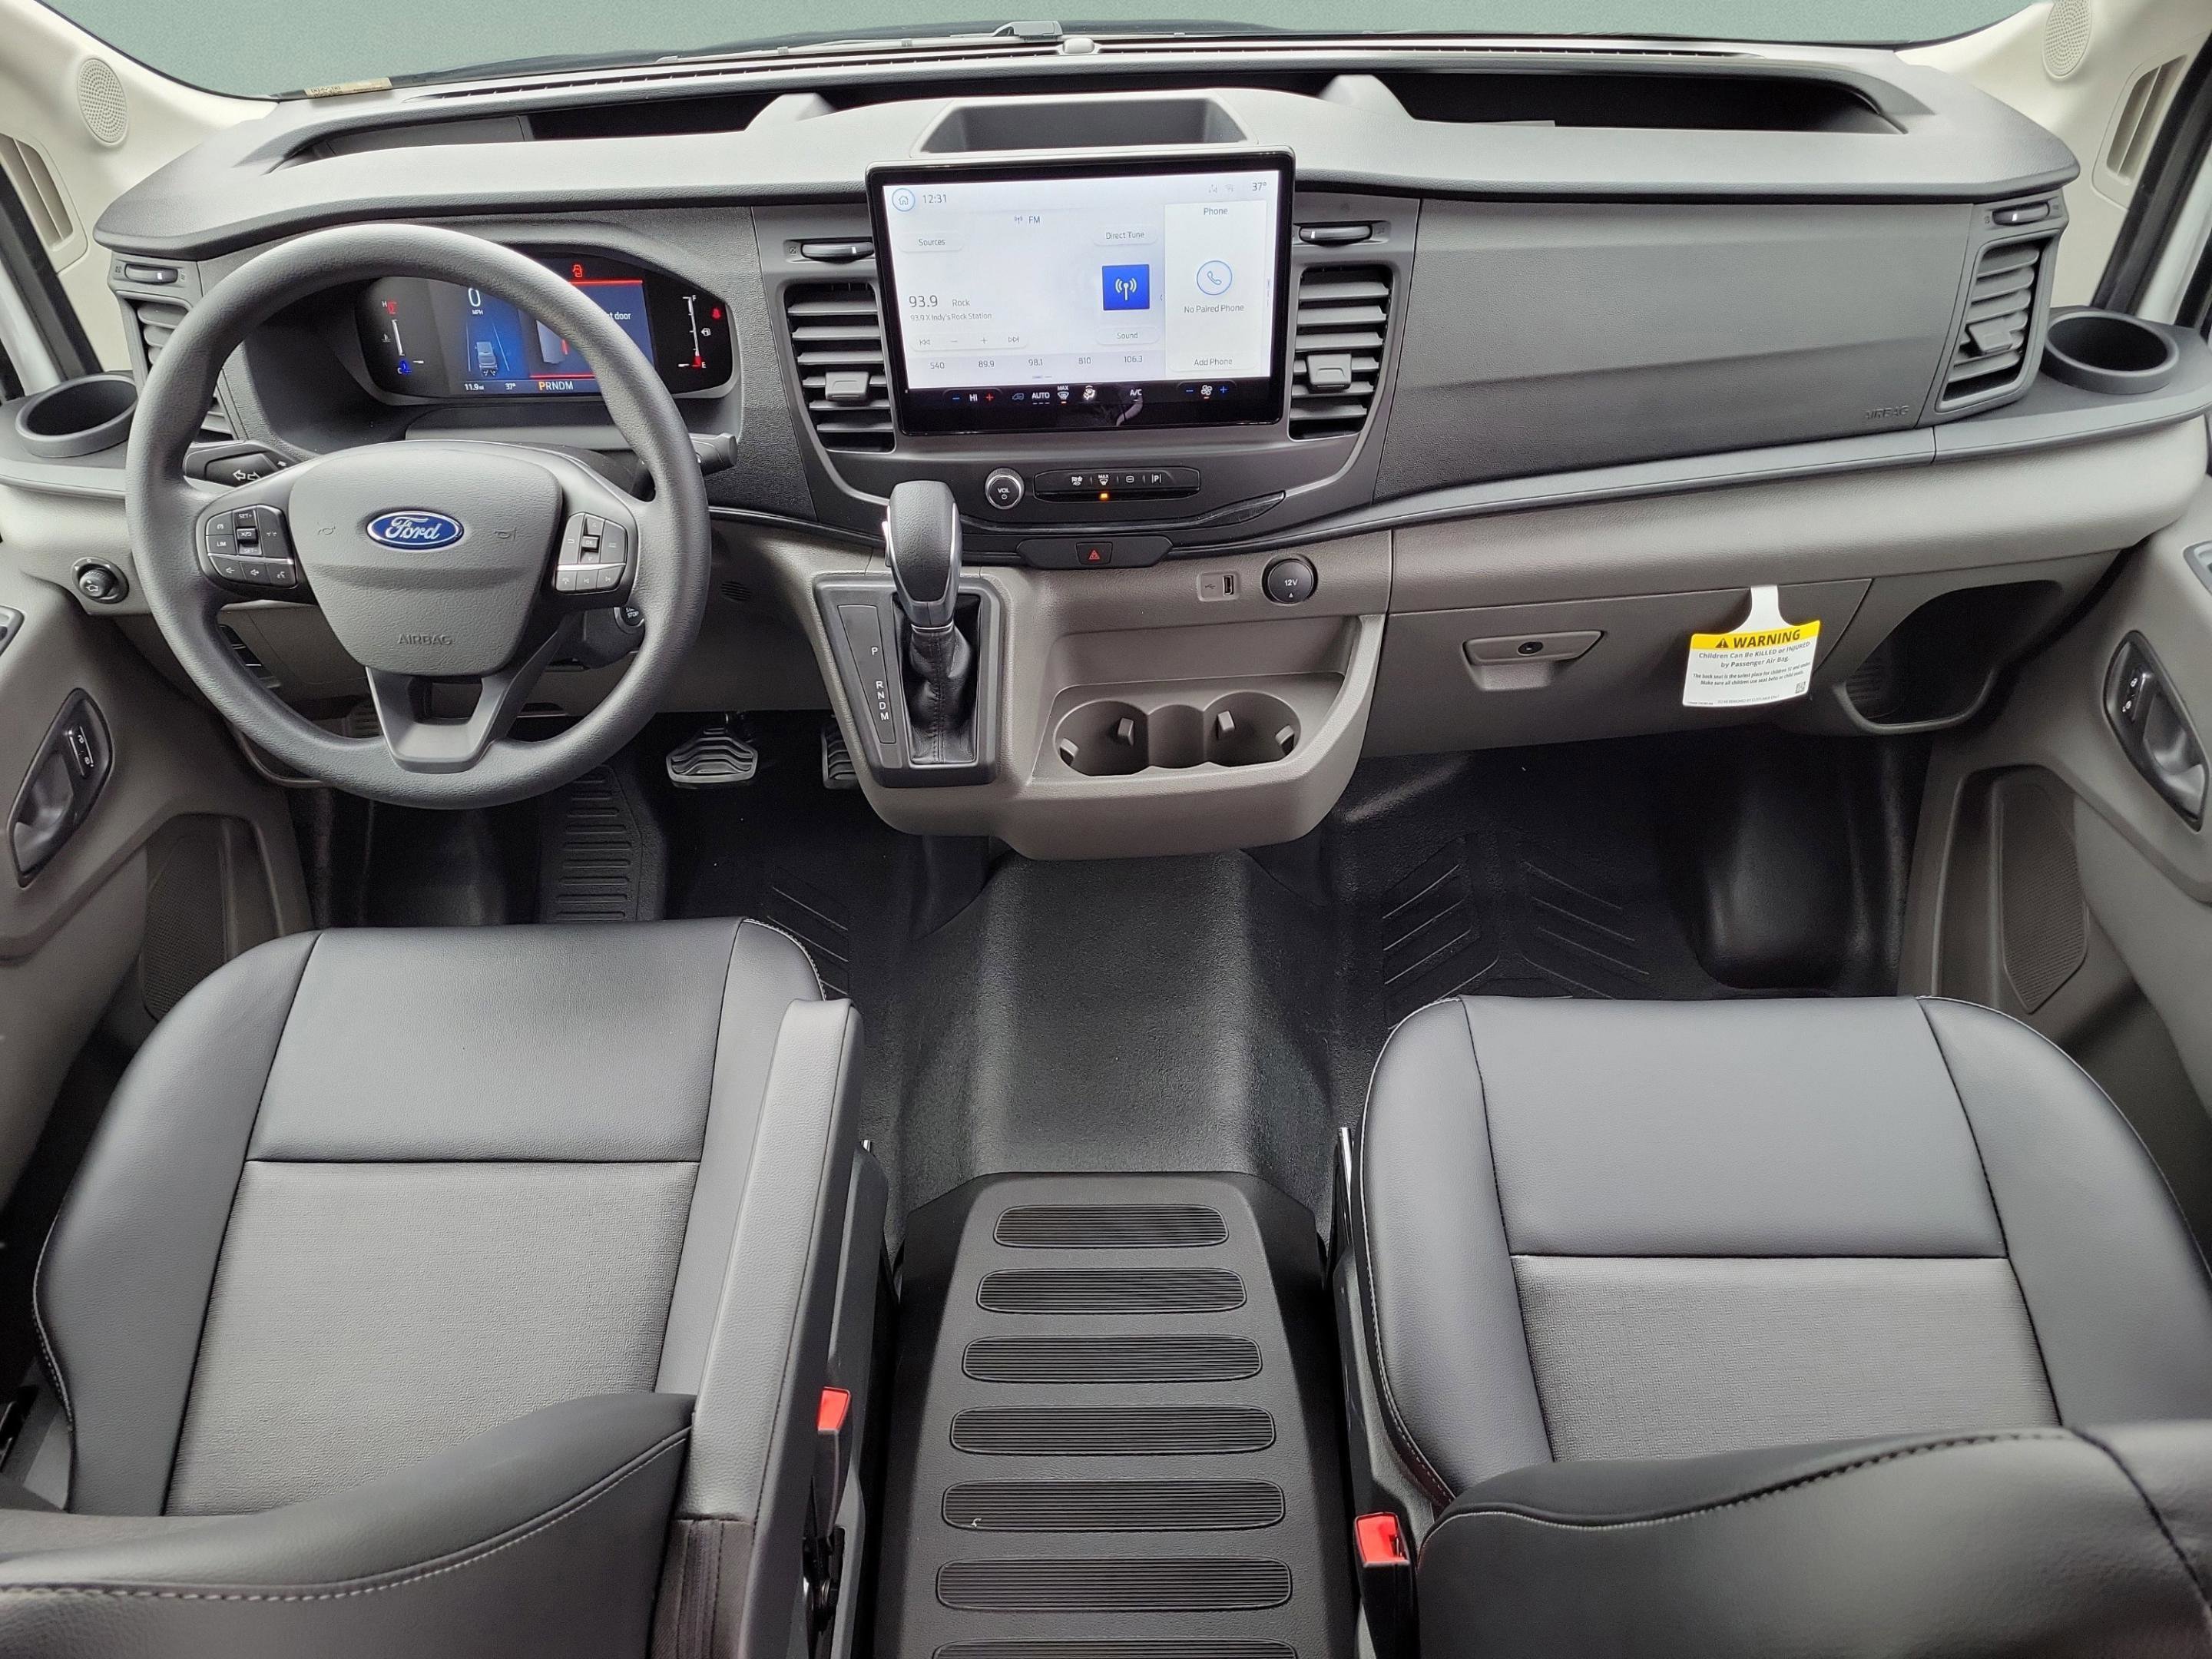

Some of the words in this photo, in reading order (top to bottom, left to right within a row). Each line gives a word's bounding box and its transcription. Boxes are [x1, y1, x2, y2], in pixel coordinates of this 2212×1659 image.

[922, 194, 947, 204] 12:31
[1105, 231, 1126, 240] Direct
[1128, 230, 1144, 239] Tune
[468, 286, 482, 307] 0
[909, 294, 939, 307] 93.9
[1220, 303, 1245, 312] Phone
[614, 310, 631, 320] door
[931, 313, 951, 322] Indy's
[978, 359, 995, 368] 89.9
[1028, 358, 1043, 366] 98.1
[1124, 355, 1143, 363] 106.3
[1194, 358, 1209, 366] Add
[1210, 356, 1233, 365] Phone
[538, 380, 574, 391] PRNDM
[1129, 388, 1143, 396] A/C
[969, 393, 978, 402] HI
[385, 515, 443, 540] Ford
[1284, 578, 1298, 587] 12V
[397, 634, 453, 646] AIRBAG
[1733, 629, 1800, 649] WARNING
[871, 647, 878, 656] P
[1754, 648, 1777, 657] KILLED
[1786, 641, 1810, 652] INJURED
[1730, 659, 1765, 667] Passenger
[876, 680, 883, 689] R
[877, 691, 885, 700] N
[879, 701, 886, 710] D
[880, 712, 889, 720] M
